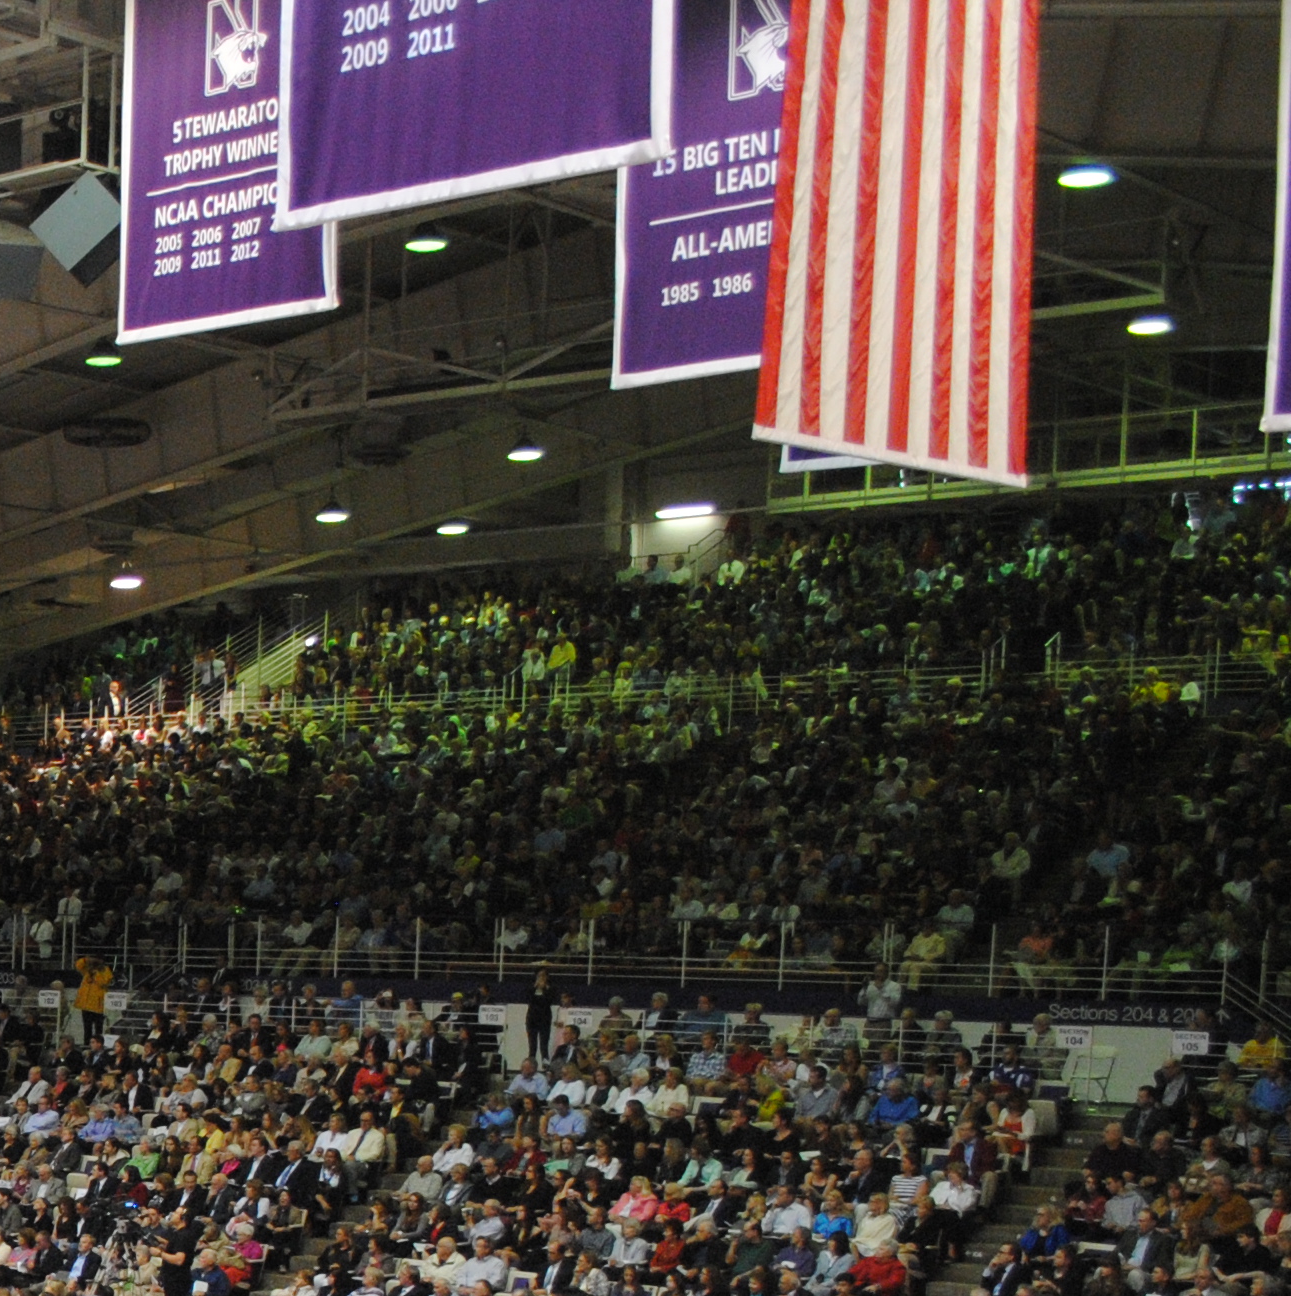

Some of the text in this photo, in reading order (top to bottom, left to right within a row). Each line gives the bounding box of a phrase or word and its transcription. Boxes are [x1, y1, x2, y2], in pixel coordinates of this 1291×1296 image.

[342, 1, 391, 36] 2004
[341, 23, 455, 73] 2009 2011
[173, 97, 278, 143] 5 TEWAARATO
[164, 131, 278, 177] TROPHY WINNE
[683, 141, 719, 171] BIG
[724, 131, 768, 163] TEN
[155, 198, 198, 229] NCAA
[155, 233, 182, 255] 2005
[191, 226, 222, 248] 2006
[231, 217, 261, 240] 2007
[153, 240, 259, 277] 2009 2011 2012
[661, 272, 752, 307] 1985 1986
[572, 1017, 587, 1026] 104
[1049, 1003, 1118, 1022] Sections
[1122, 1005, 1153, 1022] 204
[1157, 1007, 1169, 1022] &
[1065, 1037, 1083, 1045] 104
[1181, 1043, 1199, 1051] 105
